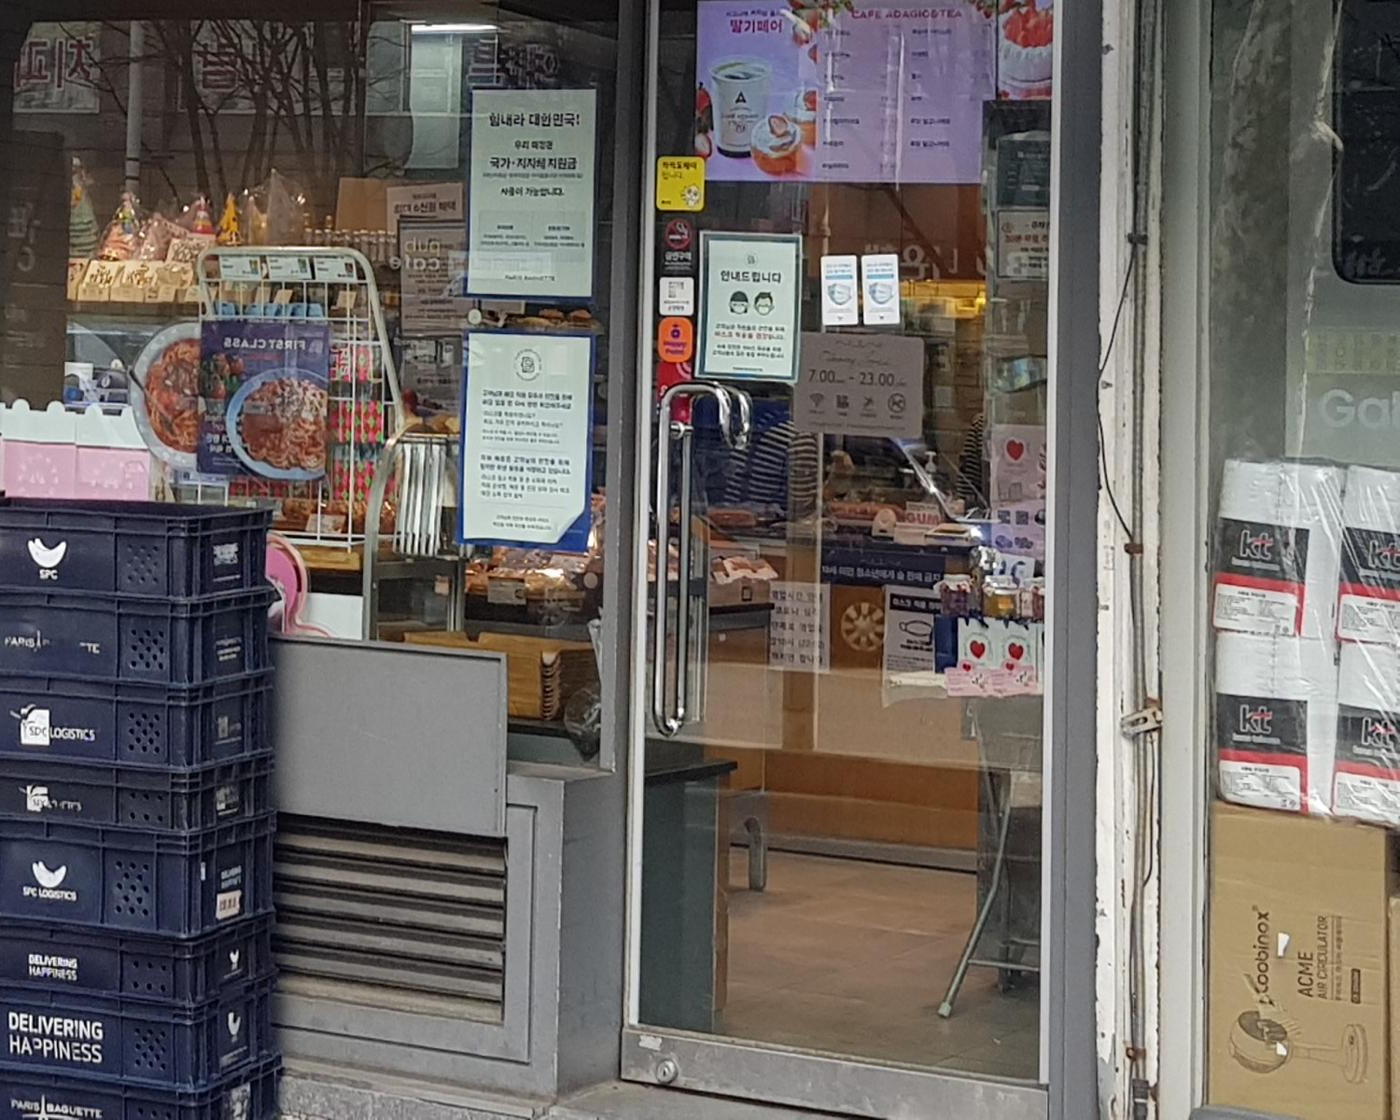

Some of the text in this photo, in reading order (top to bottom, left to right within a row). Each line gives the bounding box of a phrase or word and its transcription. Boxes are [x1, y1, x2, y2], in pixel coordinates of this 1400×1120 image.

[489, 112, 580, 127] 힘내라 대한민국!
[720, 270, 781, 283] 안내드립니다
[1240, 529, 1273, 560] kt
[1239, 704, 1273, 734] kt
[28, 954, 77, 969] DELIVERING
[1297, 951, 1314, 998] ACME
[8, 1011, 103, 1041] DELIVERING
[9, 1034, 103, 1064] HAPPINESS
[46, 1102, 103, 1118] BAGUETTE
